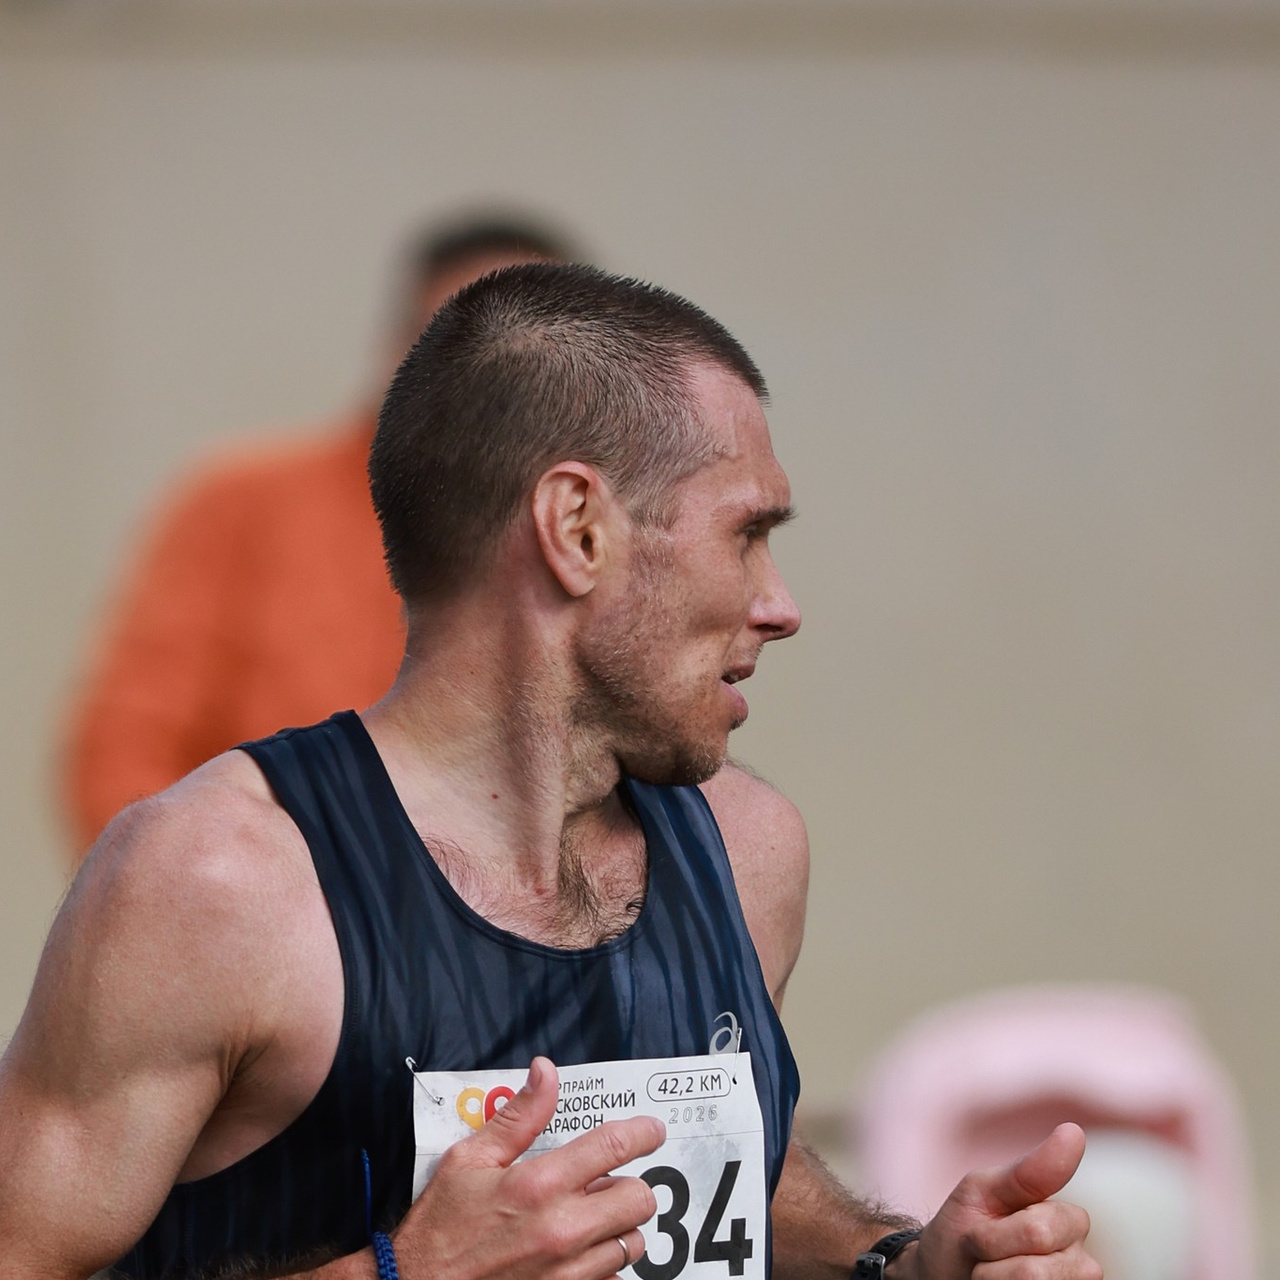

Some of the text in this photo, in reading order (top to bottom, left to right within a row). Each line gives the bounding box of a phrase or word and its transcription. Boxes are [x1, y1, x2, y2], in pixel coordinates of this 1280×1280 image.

[558, 1076, 604, 1094] ПРАЙМ
[658, 1077, 694, 1096] 42,2
[556, 1089, 635, 1114] СКОВСКИЙ
[542, 1113, 604, 1134] АРАФОН
[668, 1104, 718, 1124] 2026
